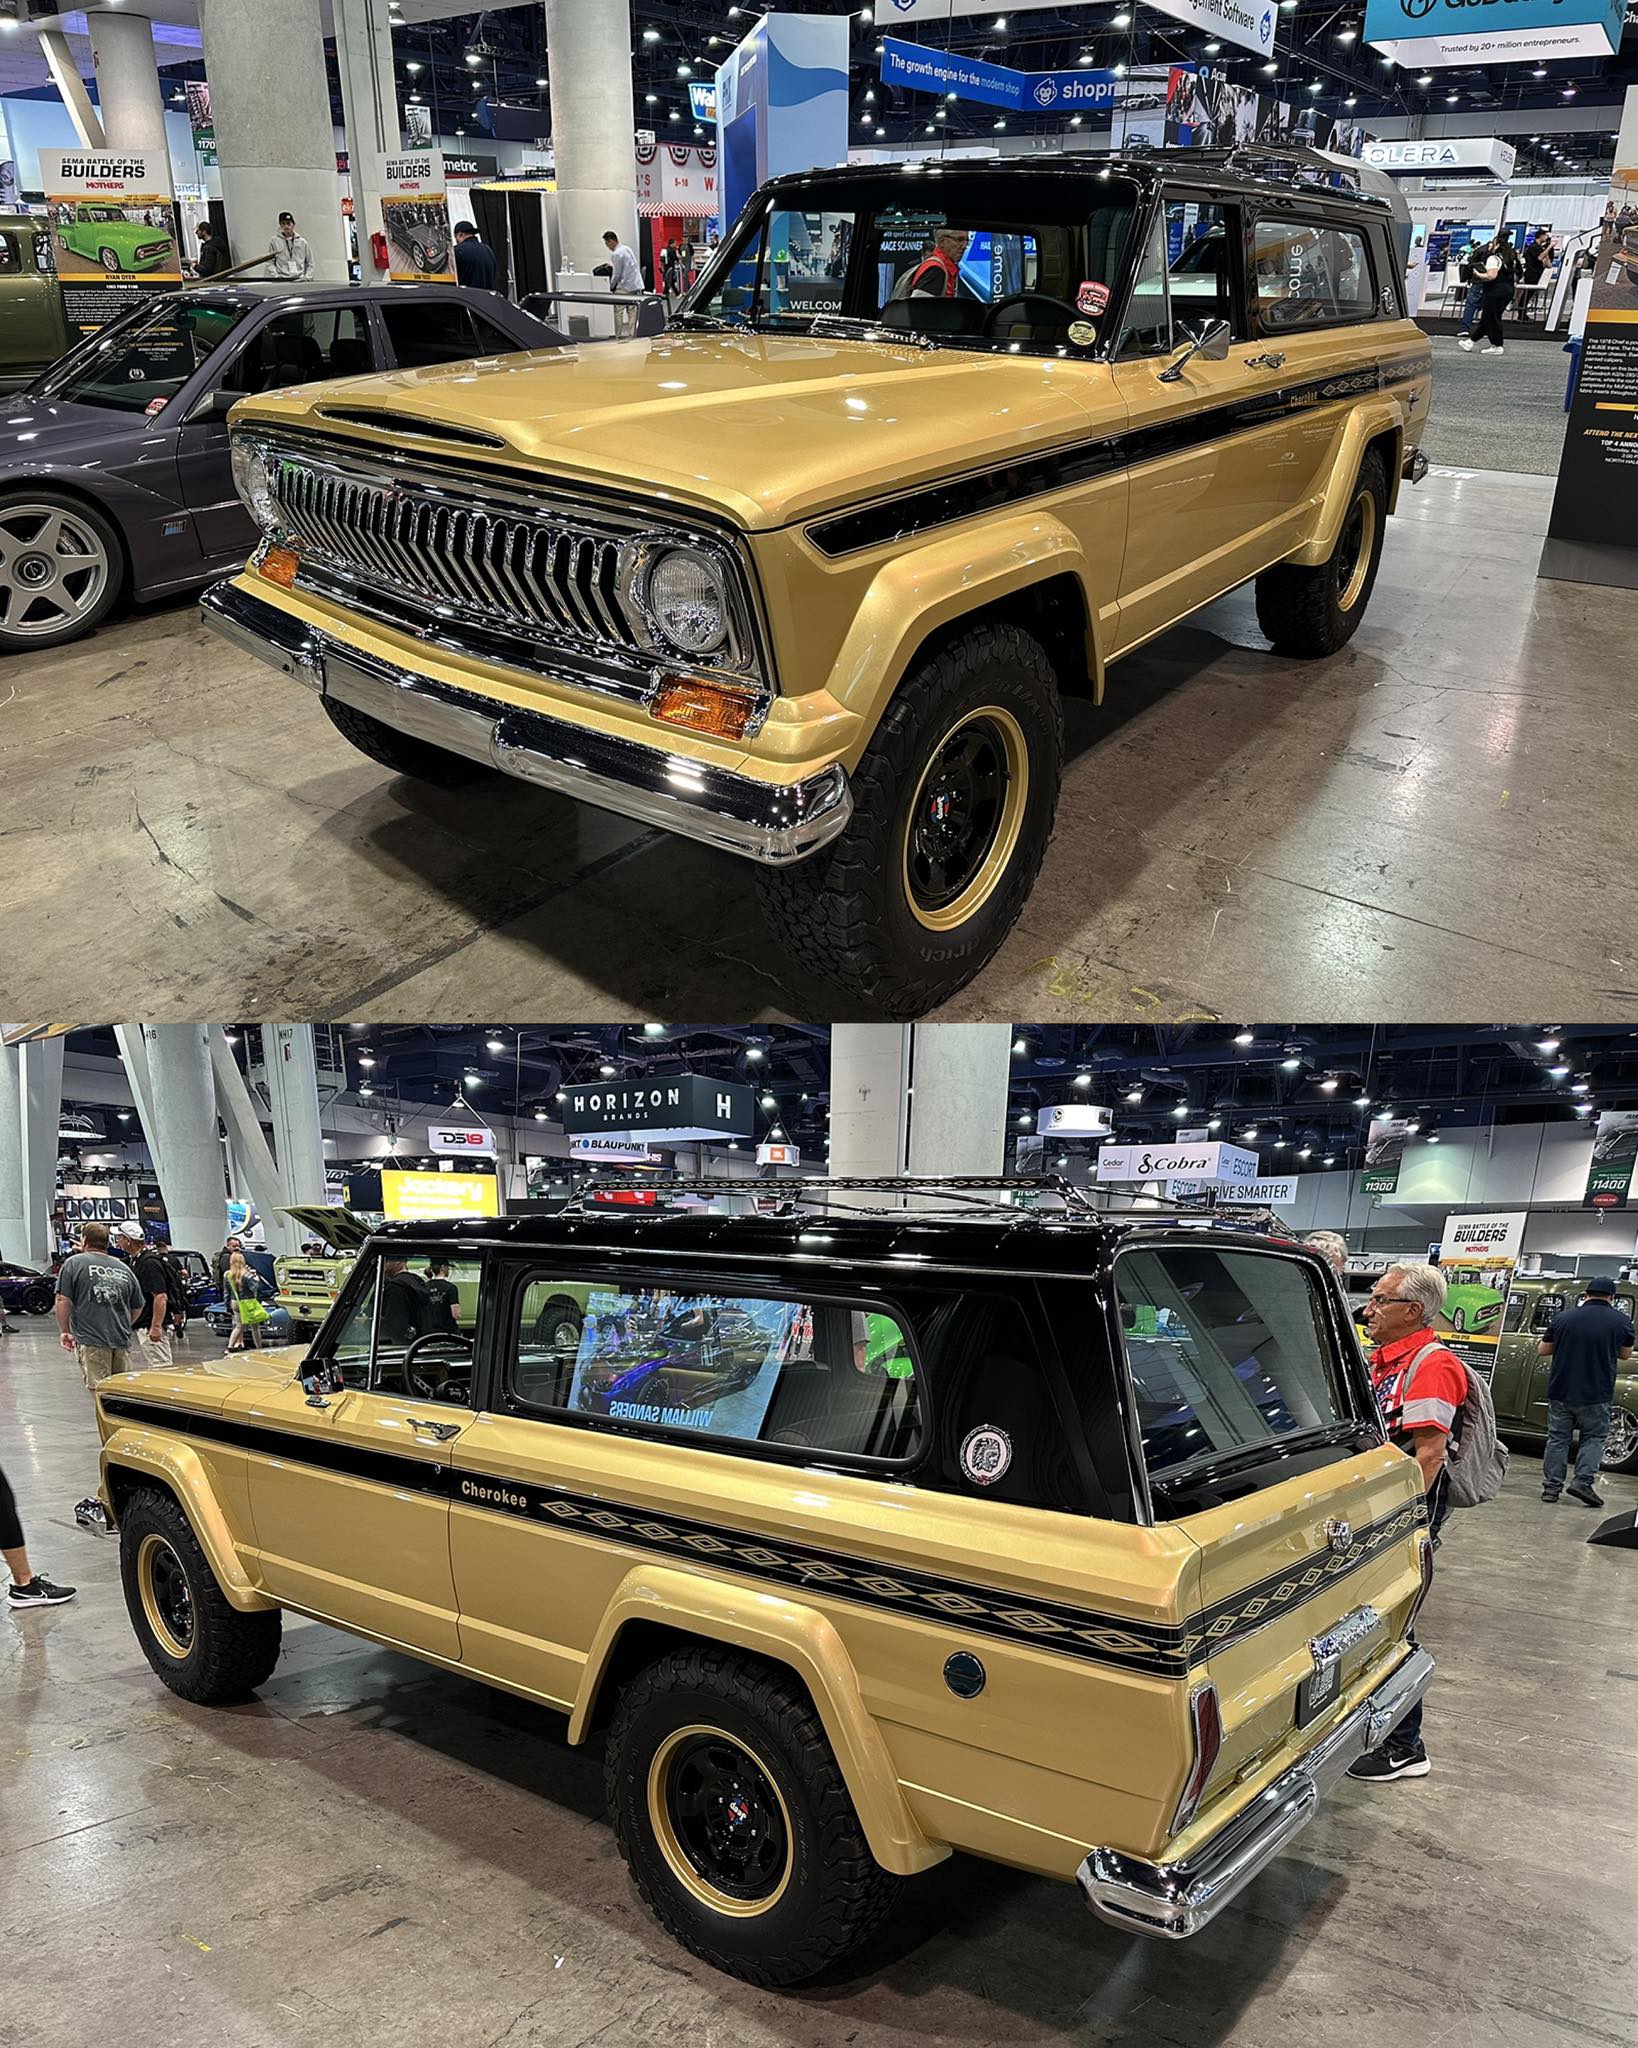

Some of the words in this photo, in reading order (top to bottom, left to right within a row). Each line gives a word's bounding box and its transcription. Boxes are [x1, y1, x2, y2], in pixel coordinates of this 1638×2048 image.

[1223, 0, 1255, 30] Software
[1440, 45, 1468, 53] Trusted
[1480, 42, 1496, 51] 20+
[1497, 41, 1522, 49] million
[1523, 36, 1581, 48] entrepreneurs.
[890, 53, 905, 69] The
[907, 60, 933, 76] growth
[934, 66, 957, 81] engine
[958, 70, 968, 83] for
[969, 73, 980, 86] the
[980, 77, 1005, 91] modern
[1005, 82, 1020, 96] shop
[398, 158, 413, 166] BATTLE
[1362, 146, 1457, 165] OLERA
[61, 165, 145, 178] BUILDERS
[386, 164, 431, 180] BUILDERS
[85, 181, 125, 190] MOTHERS
[1414, 205, 1428, 213] Body
[1429, 205, 1444, 213] Shop
[1583, 429, 1610, 437] ATTEND
[574, 1088, 679, 1112] HORIZON
[716, 1093, 731, 1119] H
[603, 1112, 648, 1121] BRANDS
[438, 1132, 483, 1145] DS18
[591, 1140, 645, 1152] BLAUPUNKT
[1102, 1159, 1124, 1167] Cedar
[1154, 1157, 1208, 1171] Cobra
[1232, 1158, 1257, 1178] ESCORT
[1365, 1182, 1393, 1191] 11300
[1592, 1180, 1626, 1190] 11400
[1237, 1185, 1288, 1199] SMARTER
[1453, 1229, 1507, 1242] BUILDERS
[461, 1480, 527, 1507] Cherokee
[729, 1802, 747, 1821] Jeep
